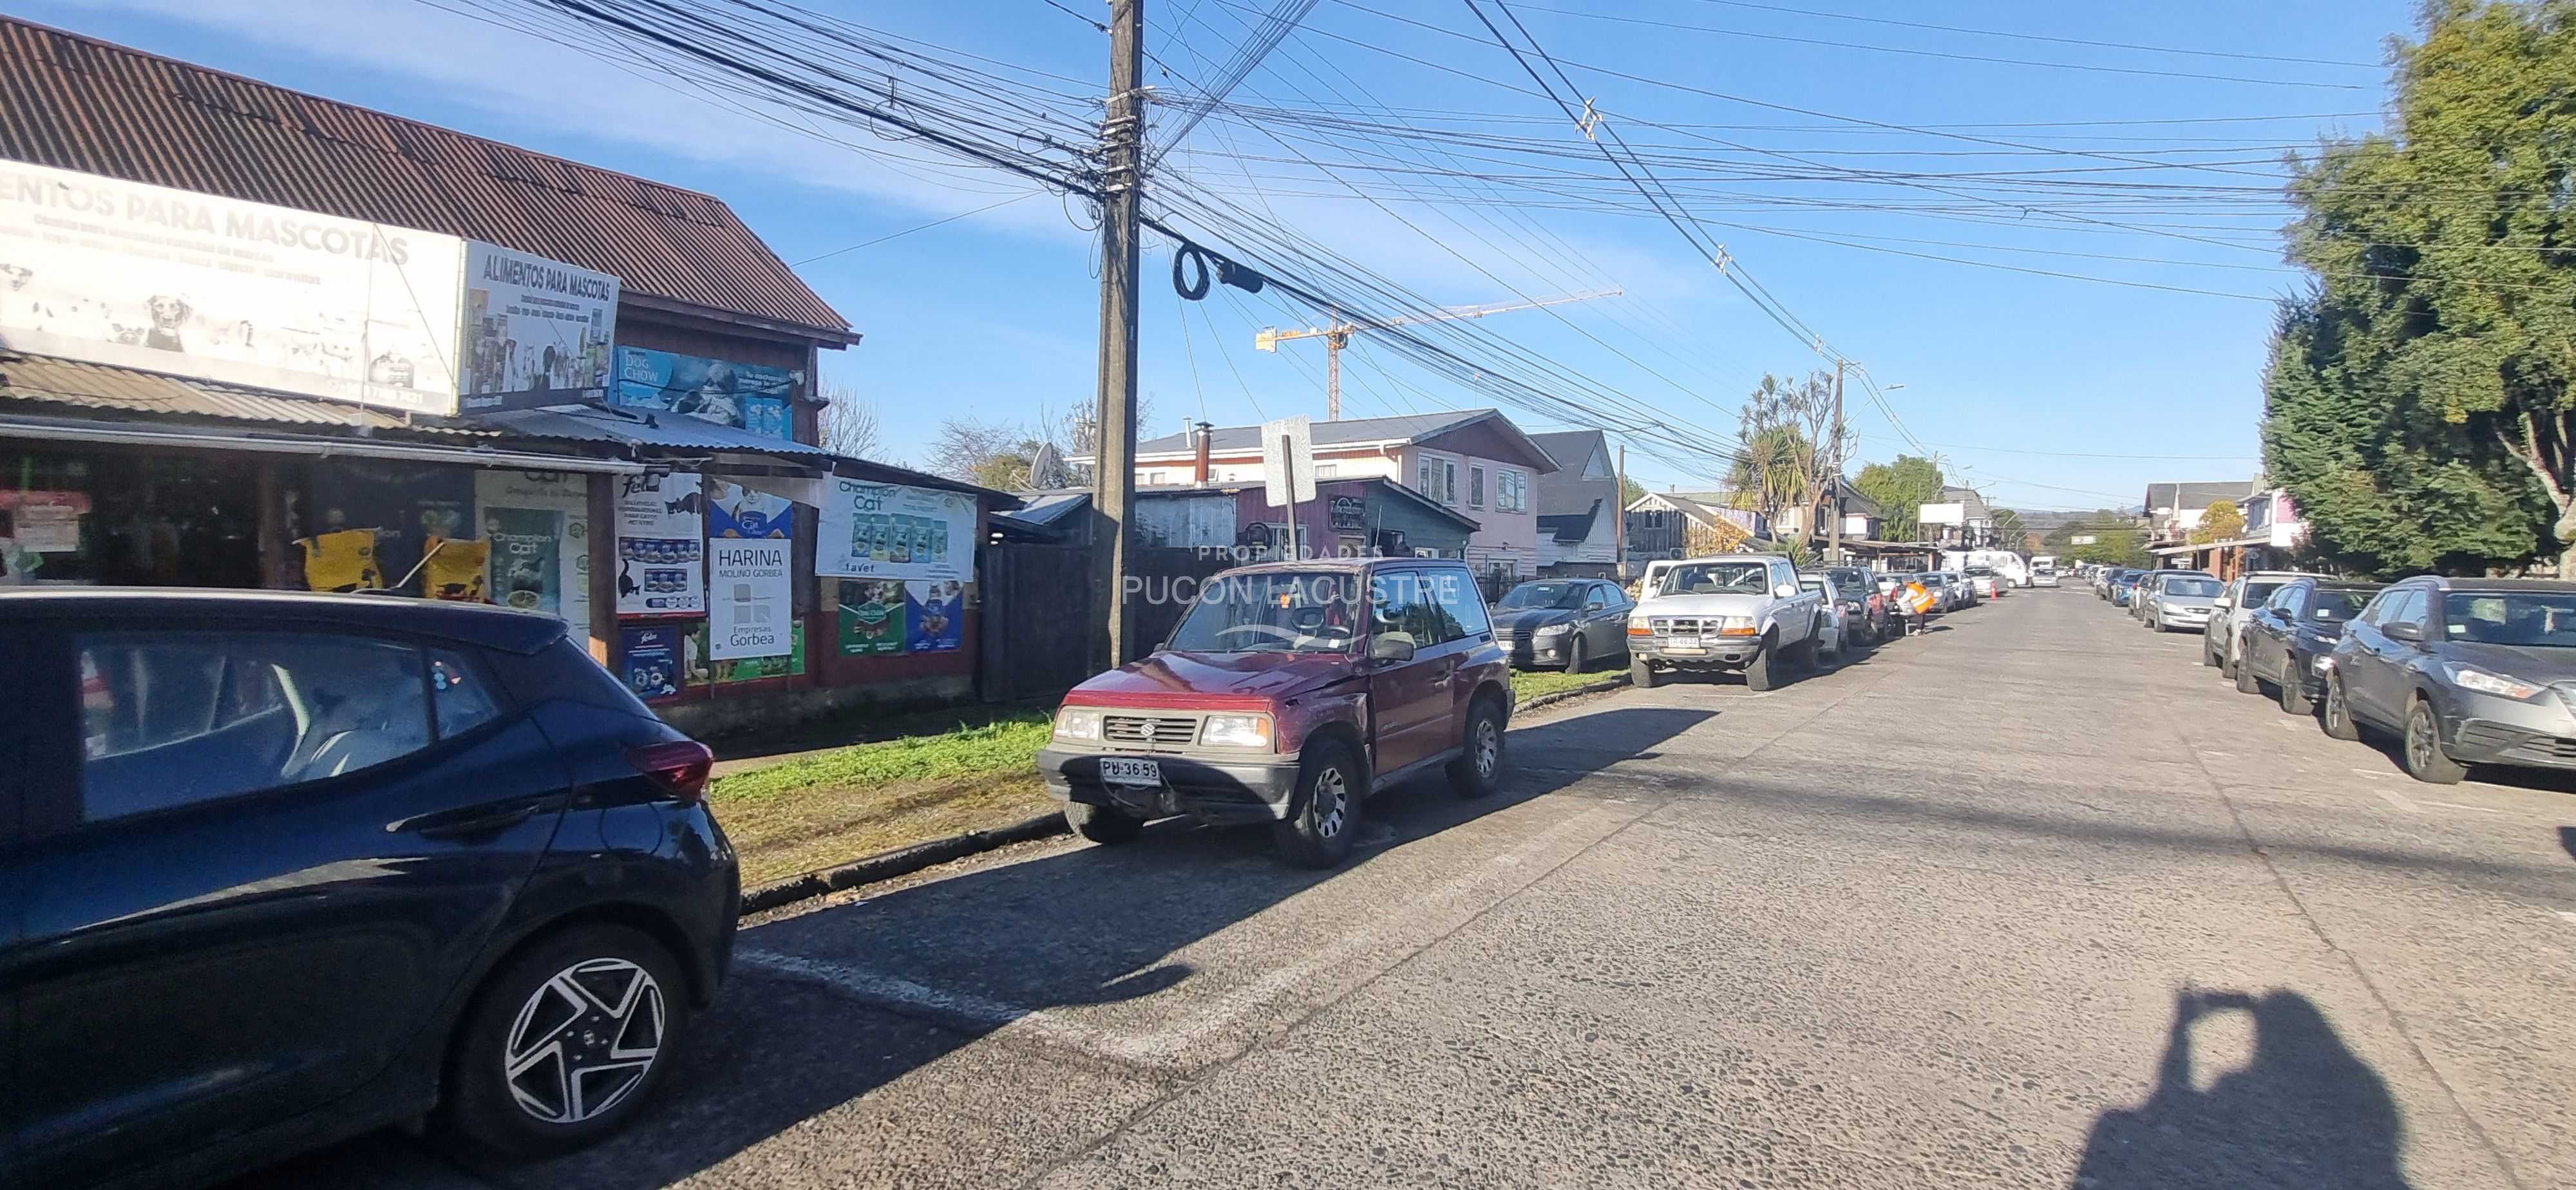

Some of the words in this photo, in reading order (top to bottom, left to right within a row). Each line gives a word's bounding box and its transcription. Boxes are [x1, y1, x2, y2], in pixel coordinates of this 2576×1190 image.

[127, 193, 215, 234] PARA
[225, 211, 409, 265] MASCOTAS
[484, 254, 544, 289] ALIMENTOS
[545, 268, 567, 294] PARA
[569, 274, 610, 301] MASCOTAS
[626, 354, 649, 369] DOG
[624, 367, 659, 382] CHOW
[854, 495, 882, 511] Cat
[719, 549, 782, 567] HARINA
[719, 569, 751, 578] MOLINO
[753, 569, 782, 578] GORBEA
[734, 626, 772, 634] Empresas
[730, 633, 775, 647] Gorbea
